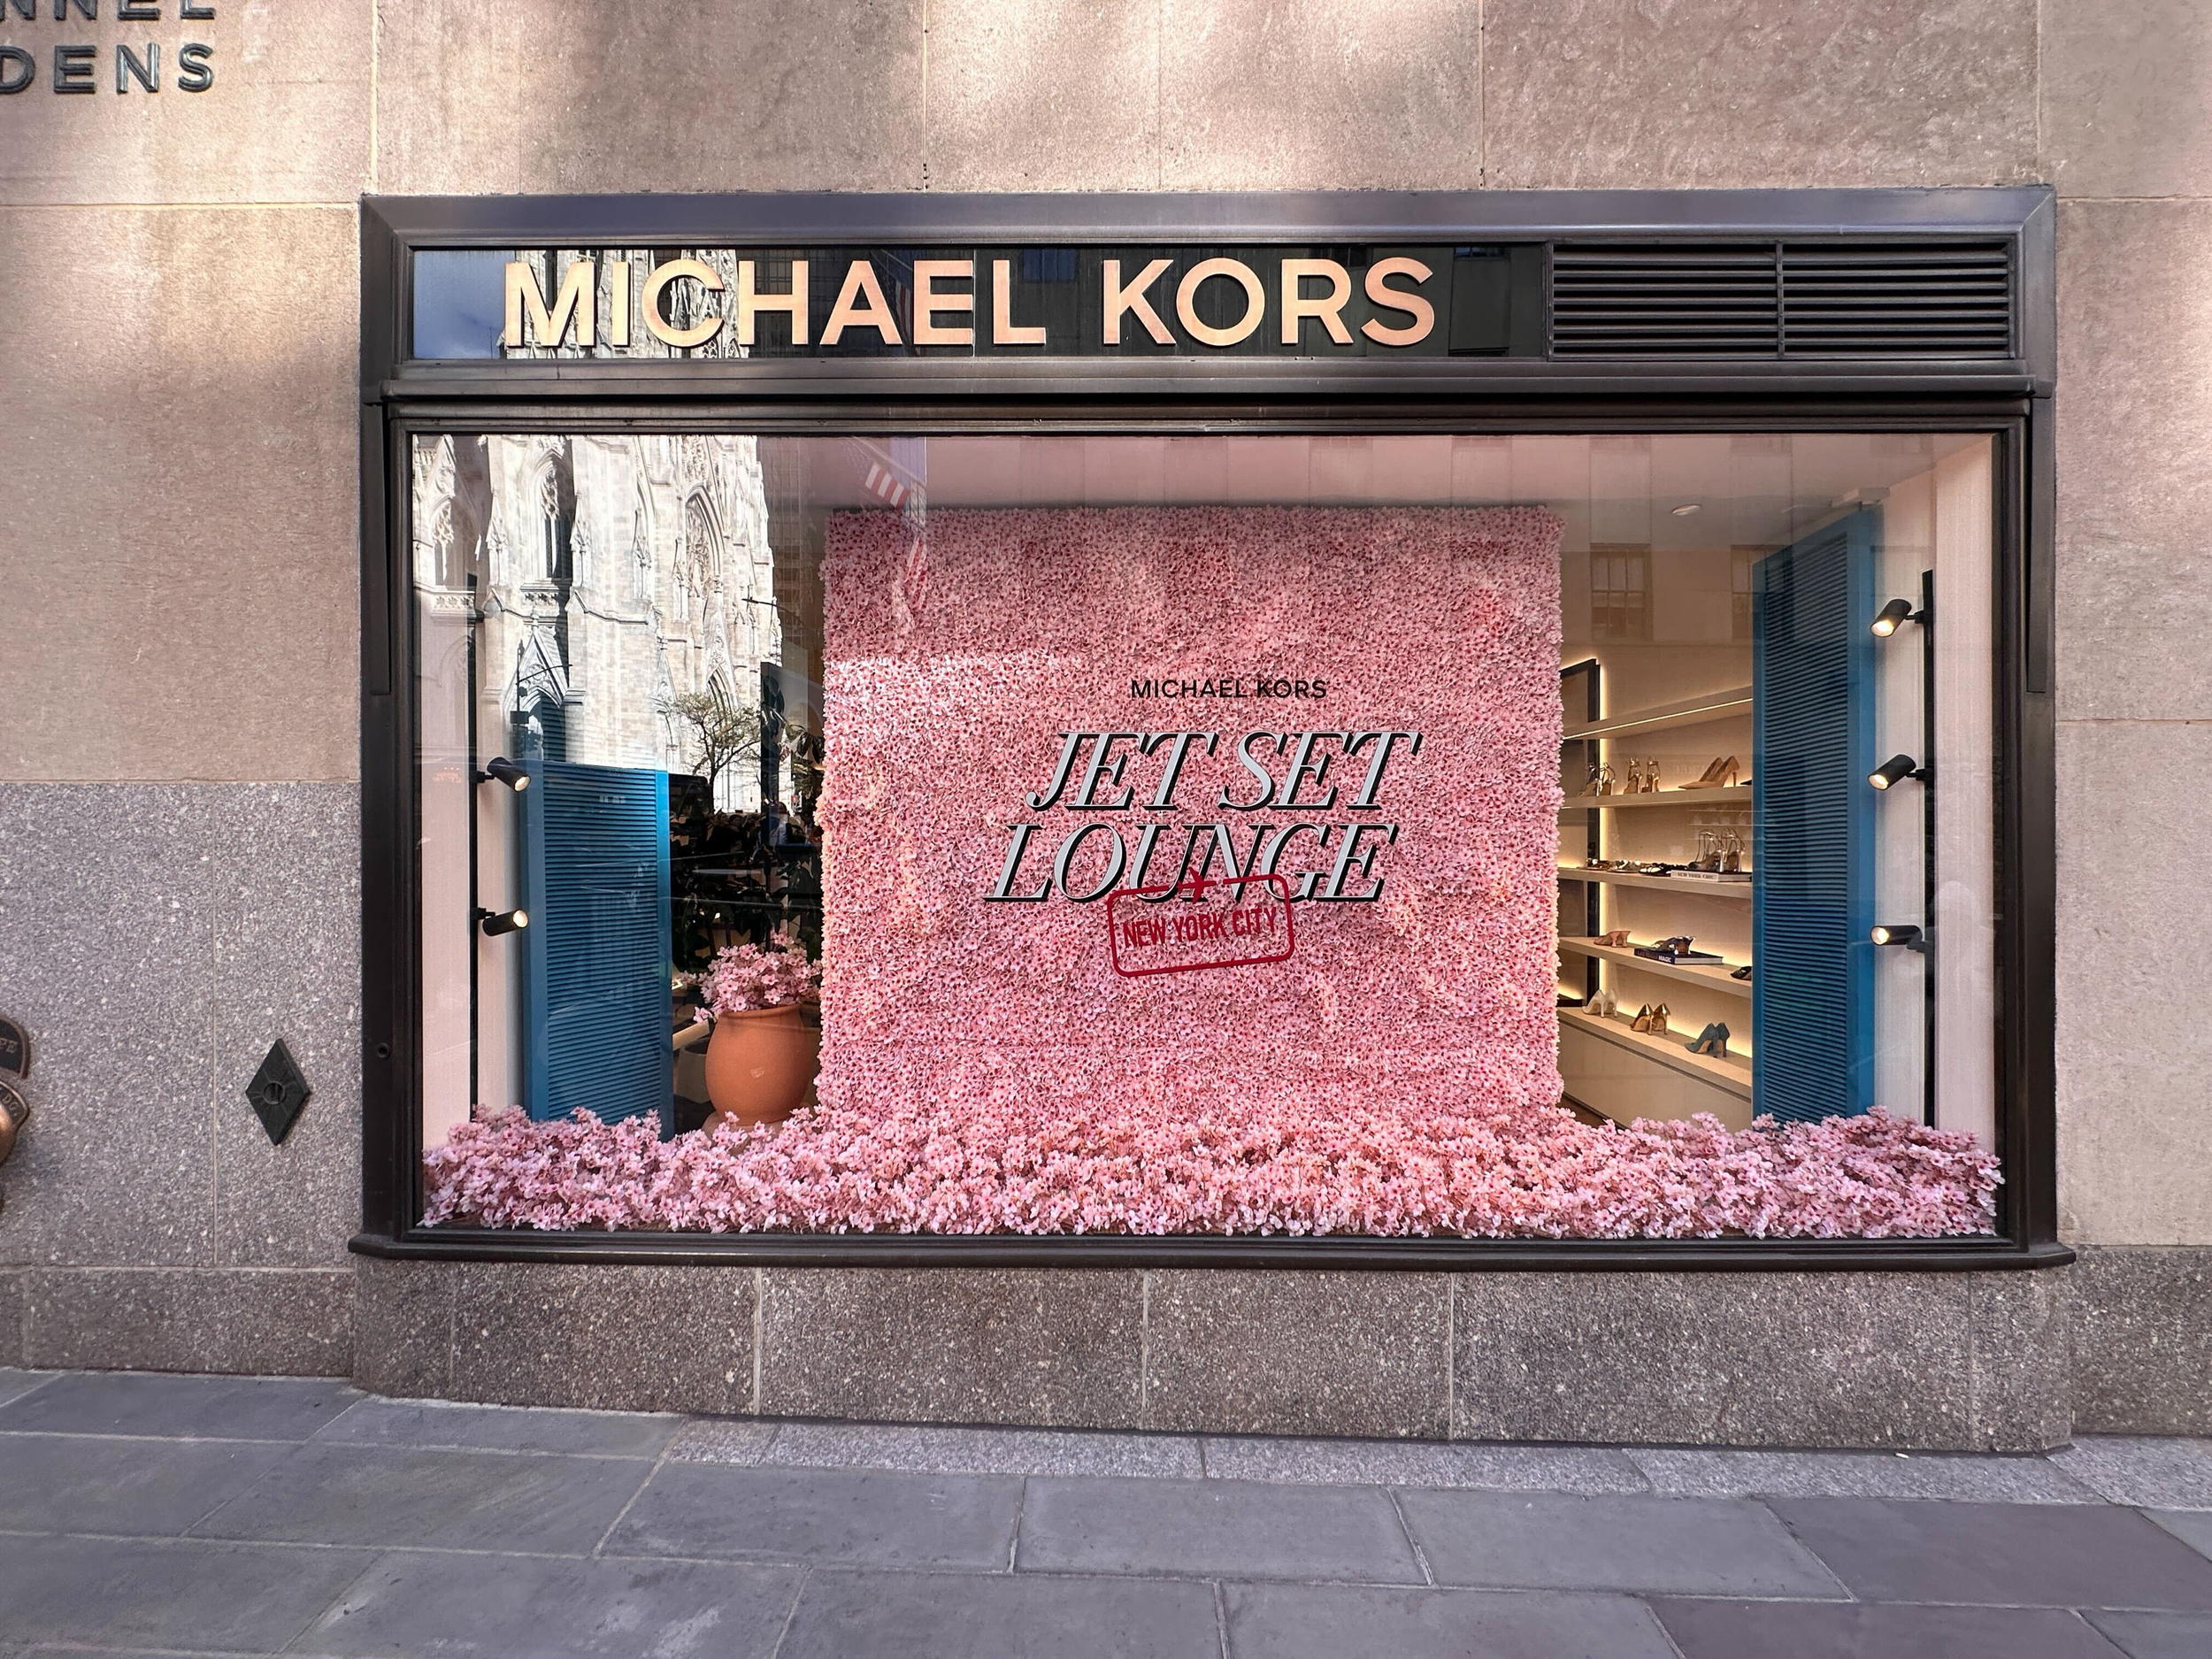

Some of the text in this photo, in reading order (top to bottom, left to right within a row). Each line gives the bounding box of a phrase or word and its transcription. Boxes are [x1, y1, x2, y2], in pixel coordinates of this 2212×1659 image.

[0, 42, 214, 95] DENS
[504, 256, 1437, 349] MICHAEL KORS
[1131, 679, 1328, 699] MICHAEL KORS
[1025, 731, 1422, 811] JET SET
[982, 822, 1399, 903] LOUNGE
[1122, 906, 1277, 949] NEW YORK CITY
